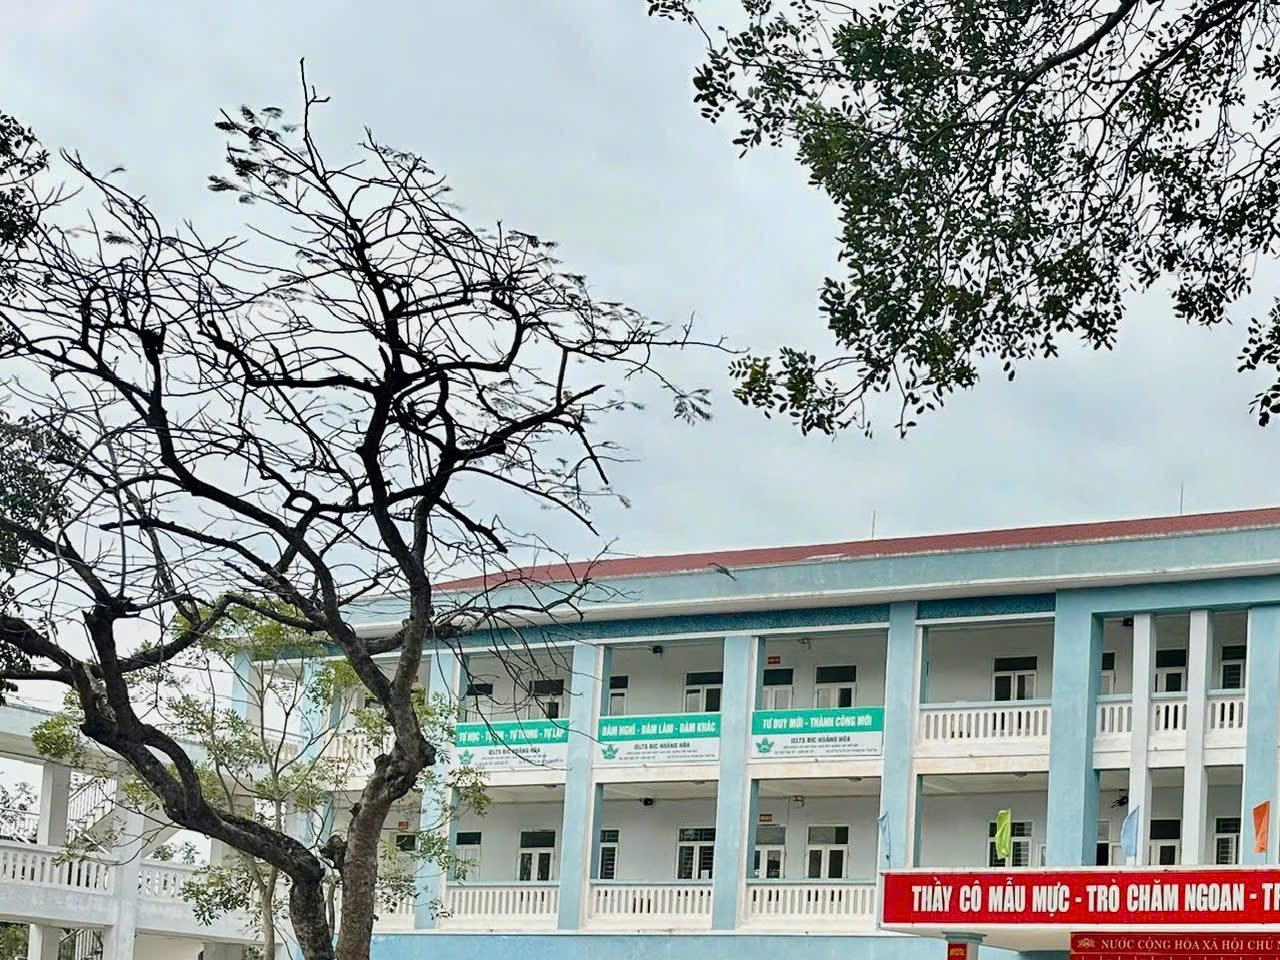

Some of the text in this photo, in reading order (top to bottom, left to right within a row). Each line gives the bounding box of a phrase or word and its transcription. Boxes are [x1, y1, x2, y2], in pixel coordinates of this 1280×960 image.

[697, 720, 716, 732] KHÁC
[773, 718, 787, 728] DUY
[789, 717, 803, 728] MỚI
[810, 715, 834, 727] THÀNH
[836, 715, 856, 726] CÔNG
[857, 714, 872, 726] MỚI
[912, 877, 952, 913] THẦY
[960, 880, 982, 913] CÔ
[988, 877, 1025, 913] MẪU
[1032, 881, 1070, 917] MỰC
[1086, 879, 1118, 913] TRÒ
[1127, 877, 1179, 912] CHĂM
[1184, 883, 1244, 911] NGOAN
[1101, 938, 1134, 950] NƯỚC
[1138, 938, 1171, 952] CỘNG
[1175, 937, 1200, 950] HÒA
[1203, 938, 1218, 950] XÃ
[1222, 938, 1243, 952] HỘI
[1248, 937, 1273, 950] CHỦ
